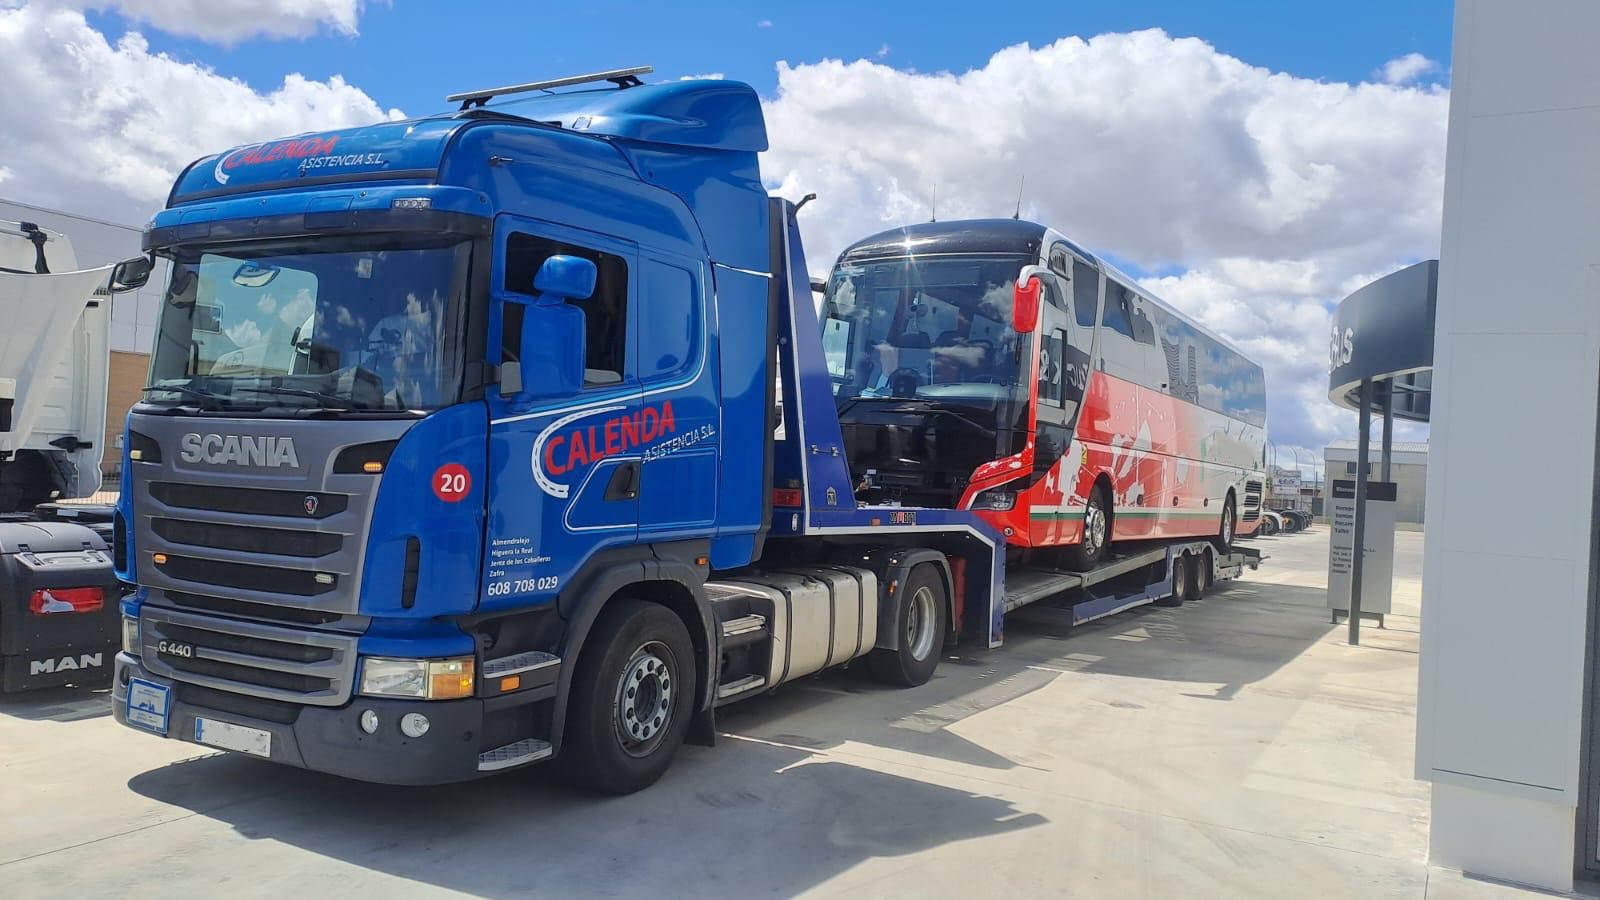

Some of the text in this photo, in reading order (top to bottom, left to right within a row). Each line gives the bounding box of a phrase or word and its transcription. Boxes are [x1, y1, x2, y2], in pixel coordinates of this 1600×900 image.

[225, 135, 340, 170] CALENDA
[297, 153, 366, 170] ASISTENCIA
[544, 400, 676, 476] CALENDA
[642, 430, 702, 465] ASISTENCIA
[180, 432, 300, 469] SCANIA
[440, 473, 466, 494] 20
[492, 537, 530, 546] Almendralejo
[514, 547, 520, 555] la
[521, 547, 533, 555] Real
[506, 558, 514, 566] de
[489, 569, 505, 578] Zafra
[487, 576, 558, 596] 608 708 029
[158, 641, 192, 658] G 440
[30, 652, 103, 676] MAN
